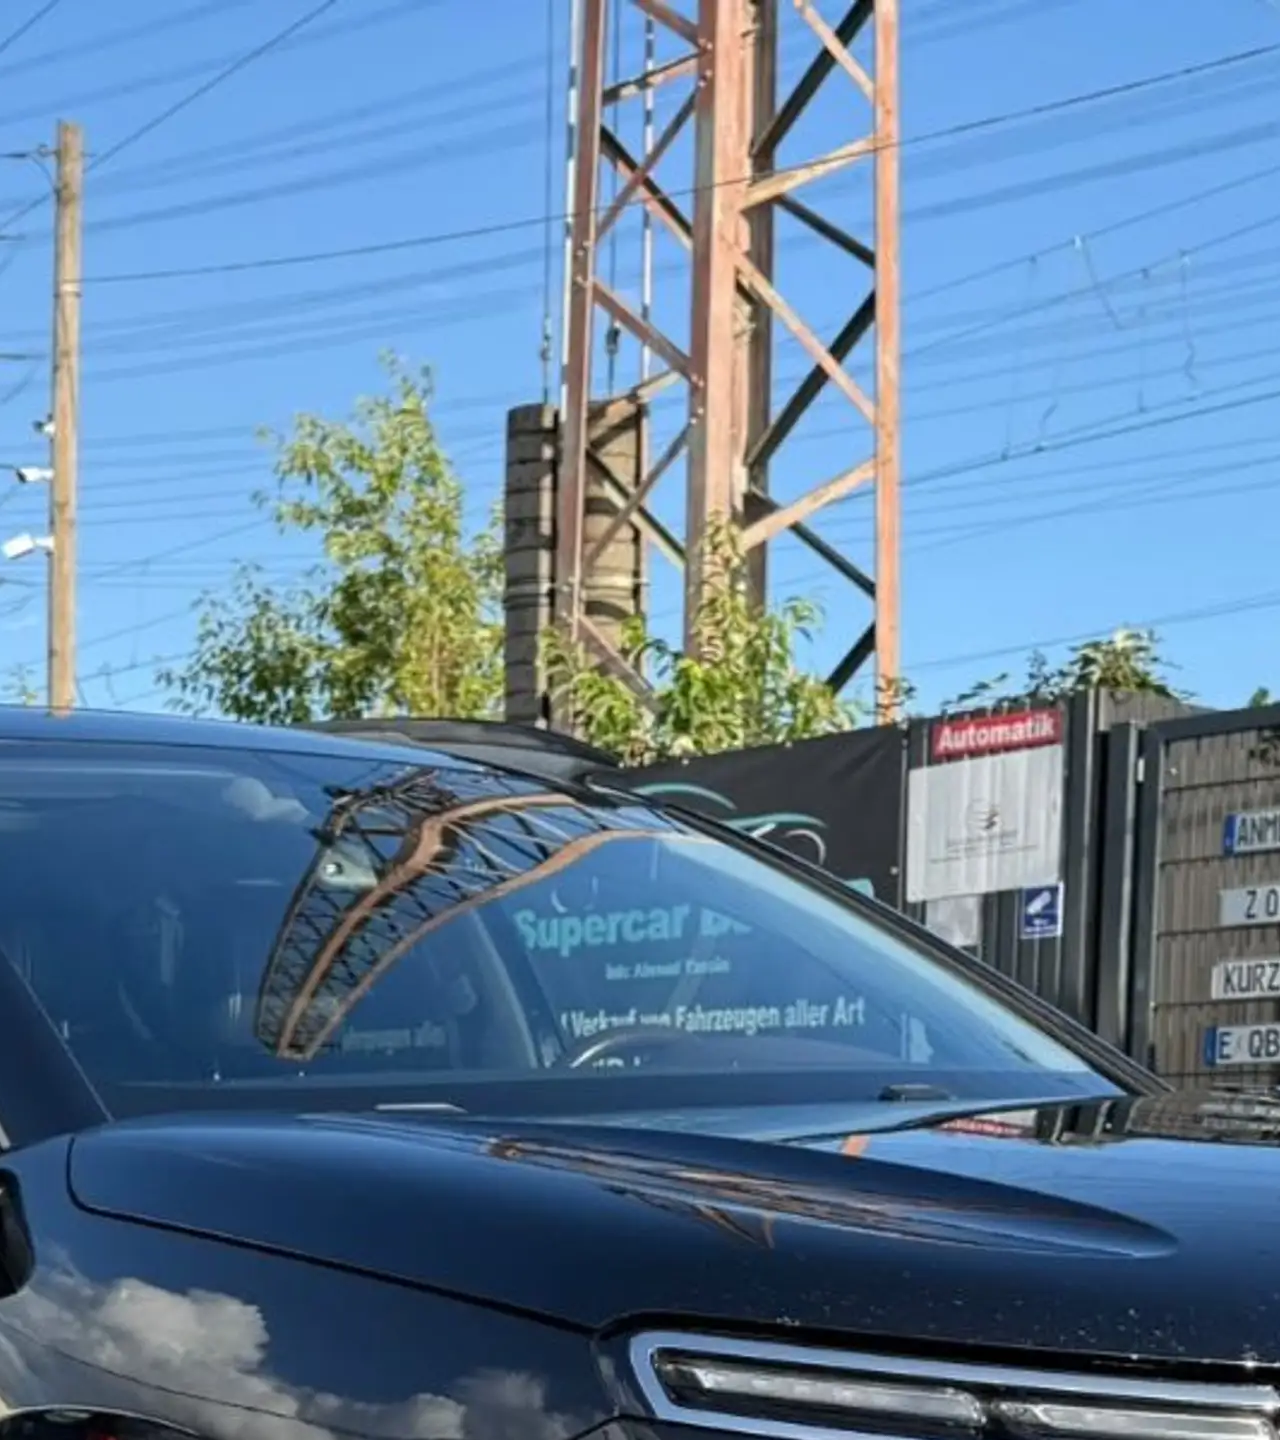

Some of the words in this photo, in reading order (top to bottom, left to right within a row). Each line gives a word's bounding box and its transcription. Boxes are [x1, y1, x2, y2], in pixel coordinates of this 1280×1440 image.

[937, 714, 1055, 751] Automatik
[513, 904, 690, 957] Supercar
[676, 1005, 780, 1036] Fahrzeugen
[784, 999, 829, 1027] aller
[833, 997, 865, 1026] Art
